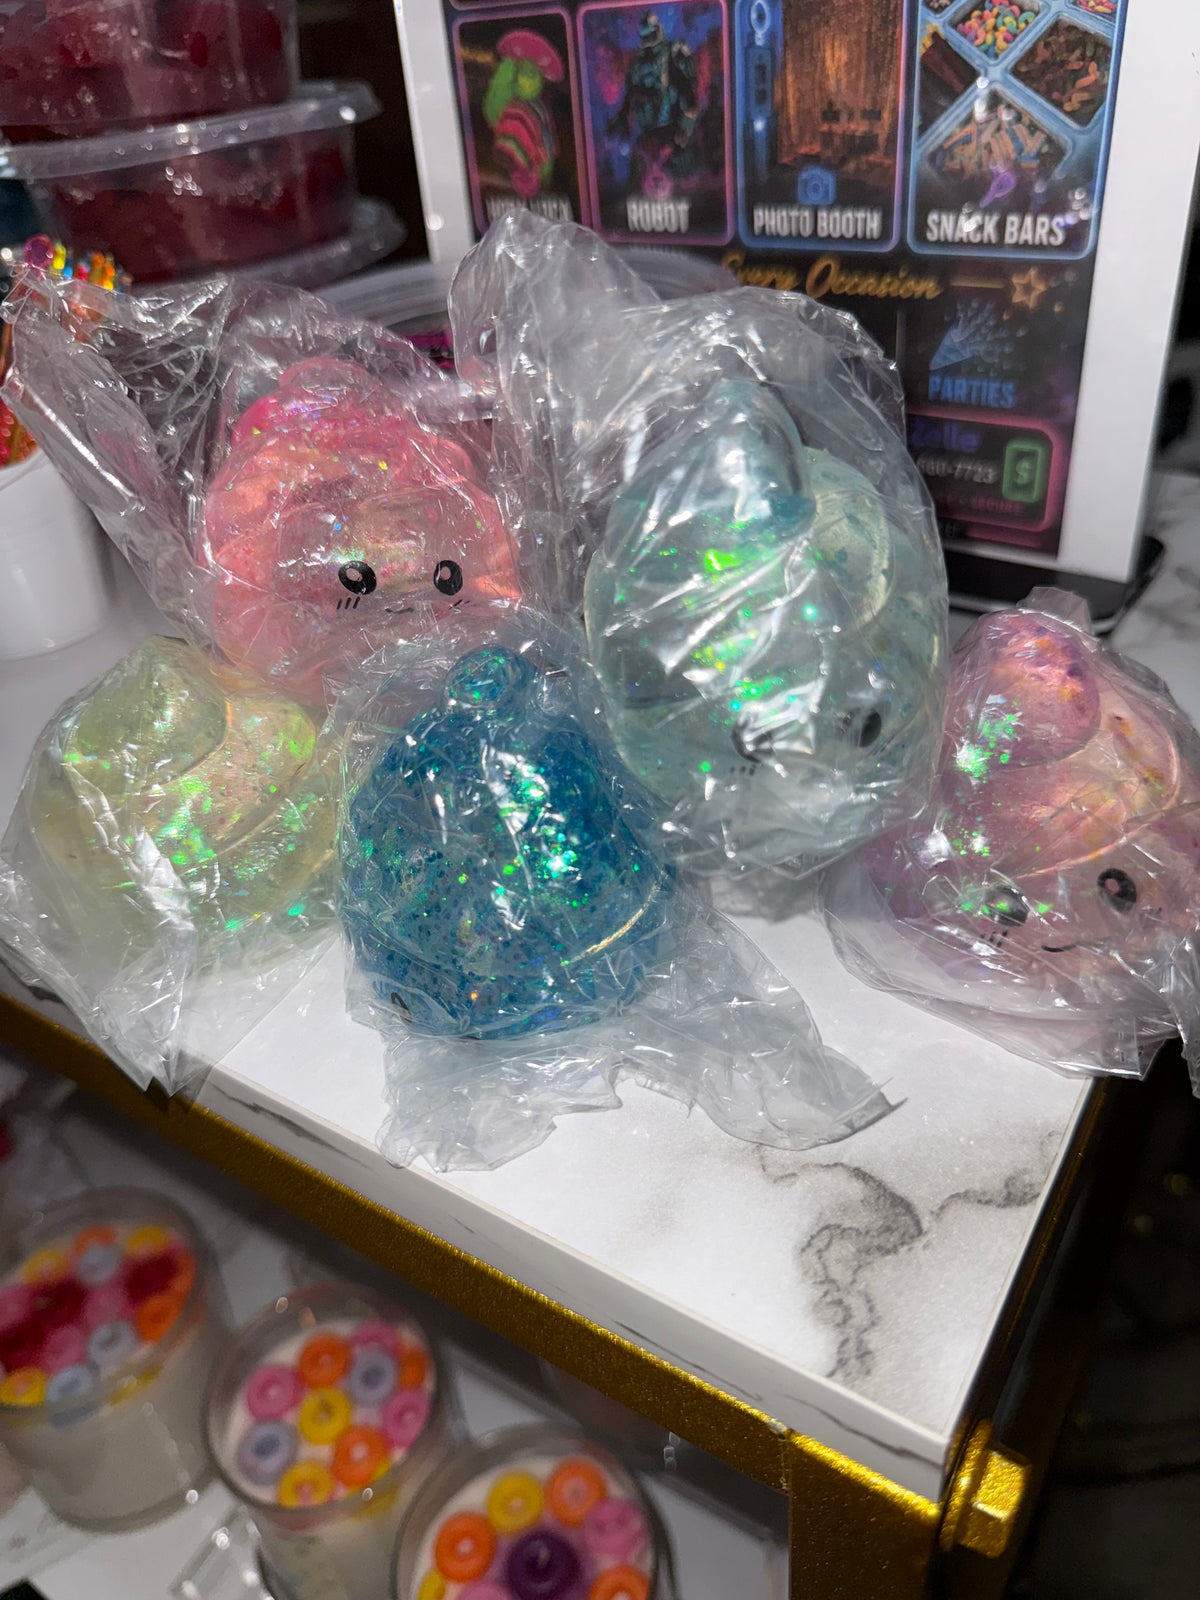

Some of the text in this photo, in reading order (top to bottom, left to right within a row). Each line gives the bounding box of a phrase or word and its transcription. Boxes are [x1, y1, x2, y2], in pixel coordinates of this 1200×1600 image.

[626, 197, 690, 233] ROBOT
[752, 205, 883, 240] PHOTO BOOTH
[926, 209, 1066, 247] SNACK BARS
[805, 255, 944, 300] Occasion
[929, 374, 1017, 408] PARTIES
